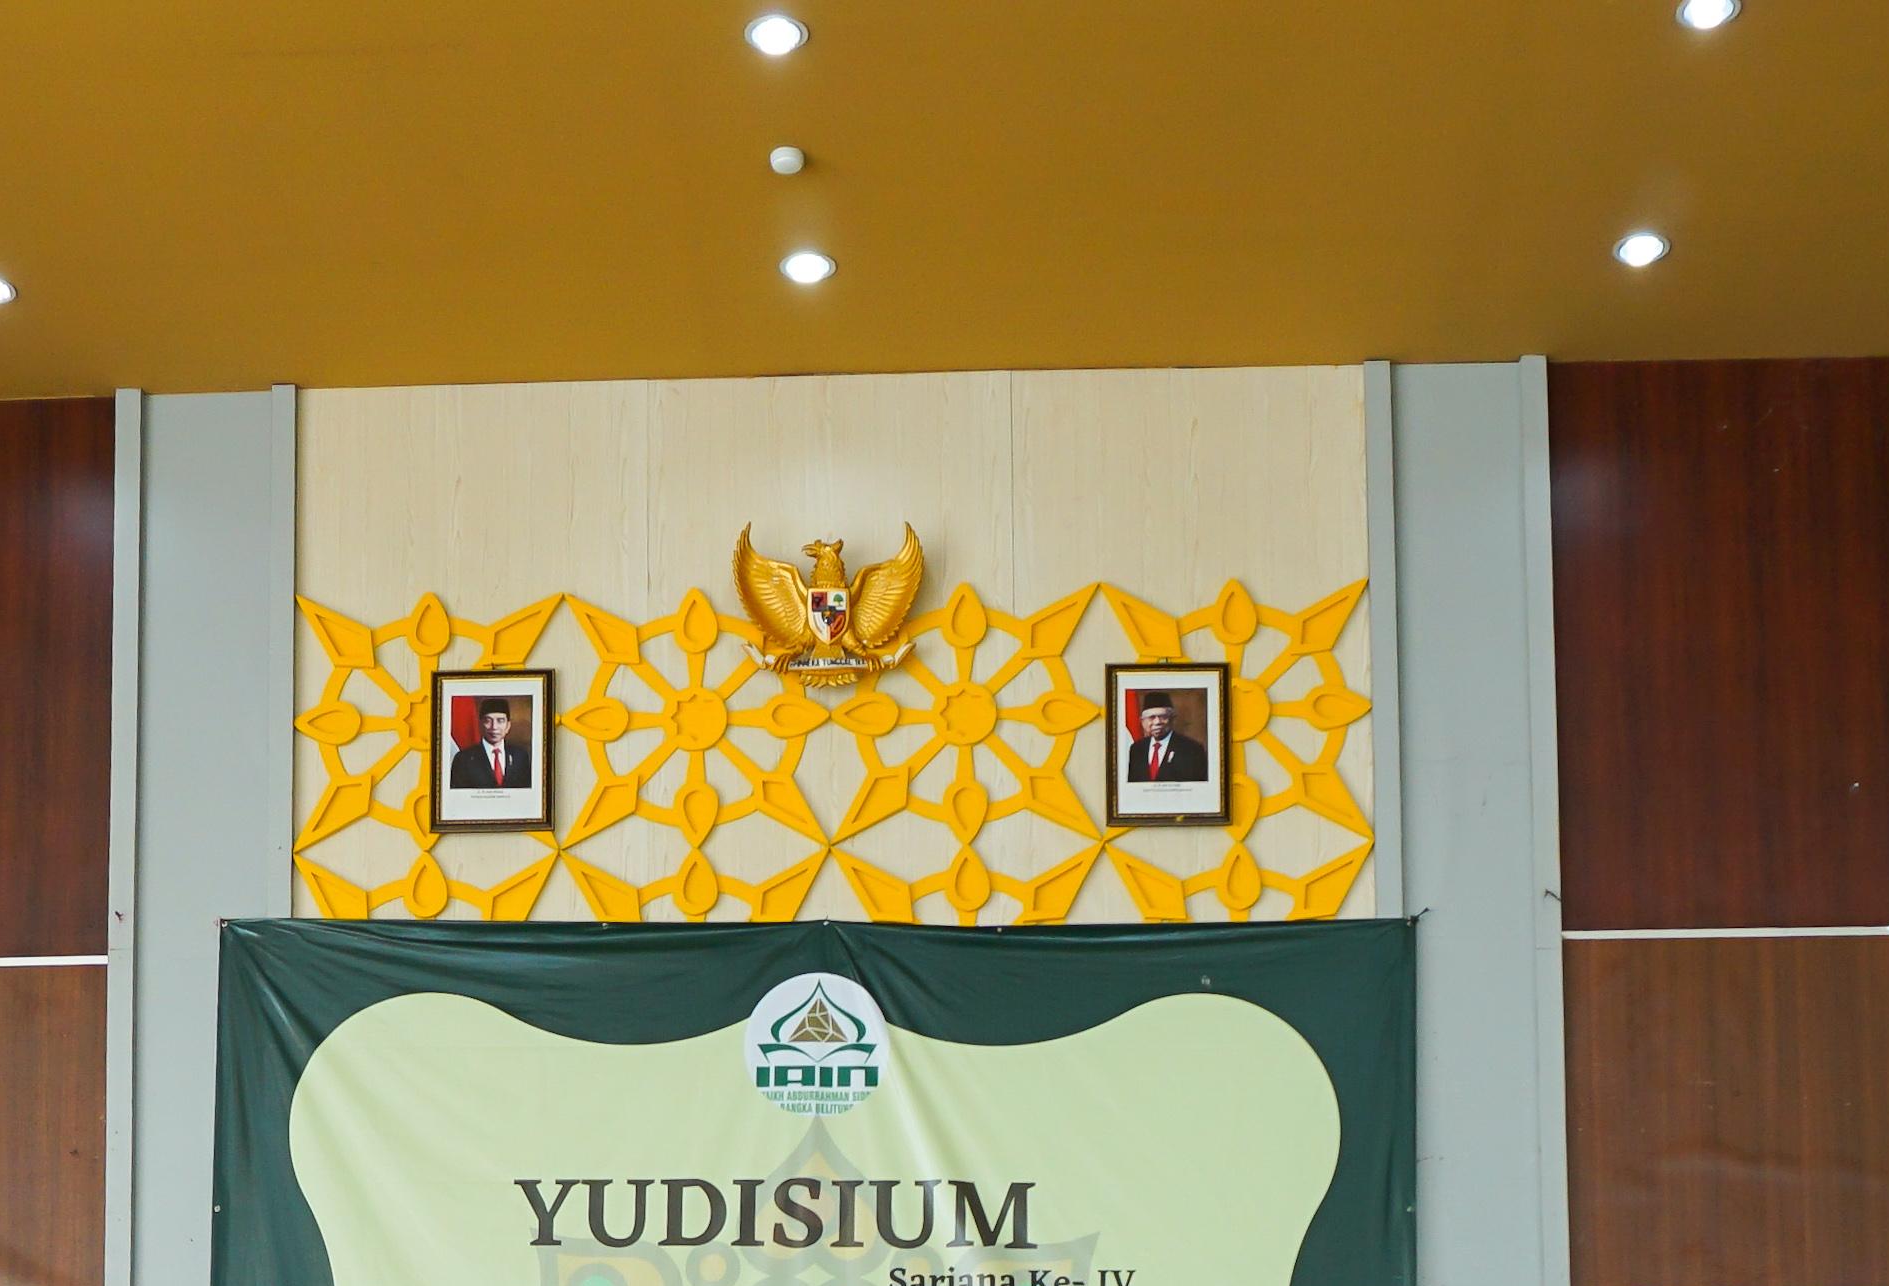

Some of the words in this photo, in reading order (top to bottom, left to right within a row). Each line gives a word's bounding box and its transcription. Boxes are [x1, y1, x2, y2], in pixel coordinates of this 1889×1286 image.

[756, 1065, 879, 1087] IAIN
[786, 1091, 849, 1101] ABDURRAHMAN
[513, 1177, 1039, 1250] YUDISIUM
